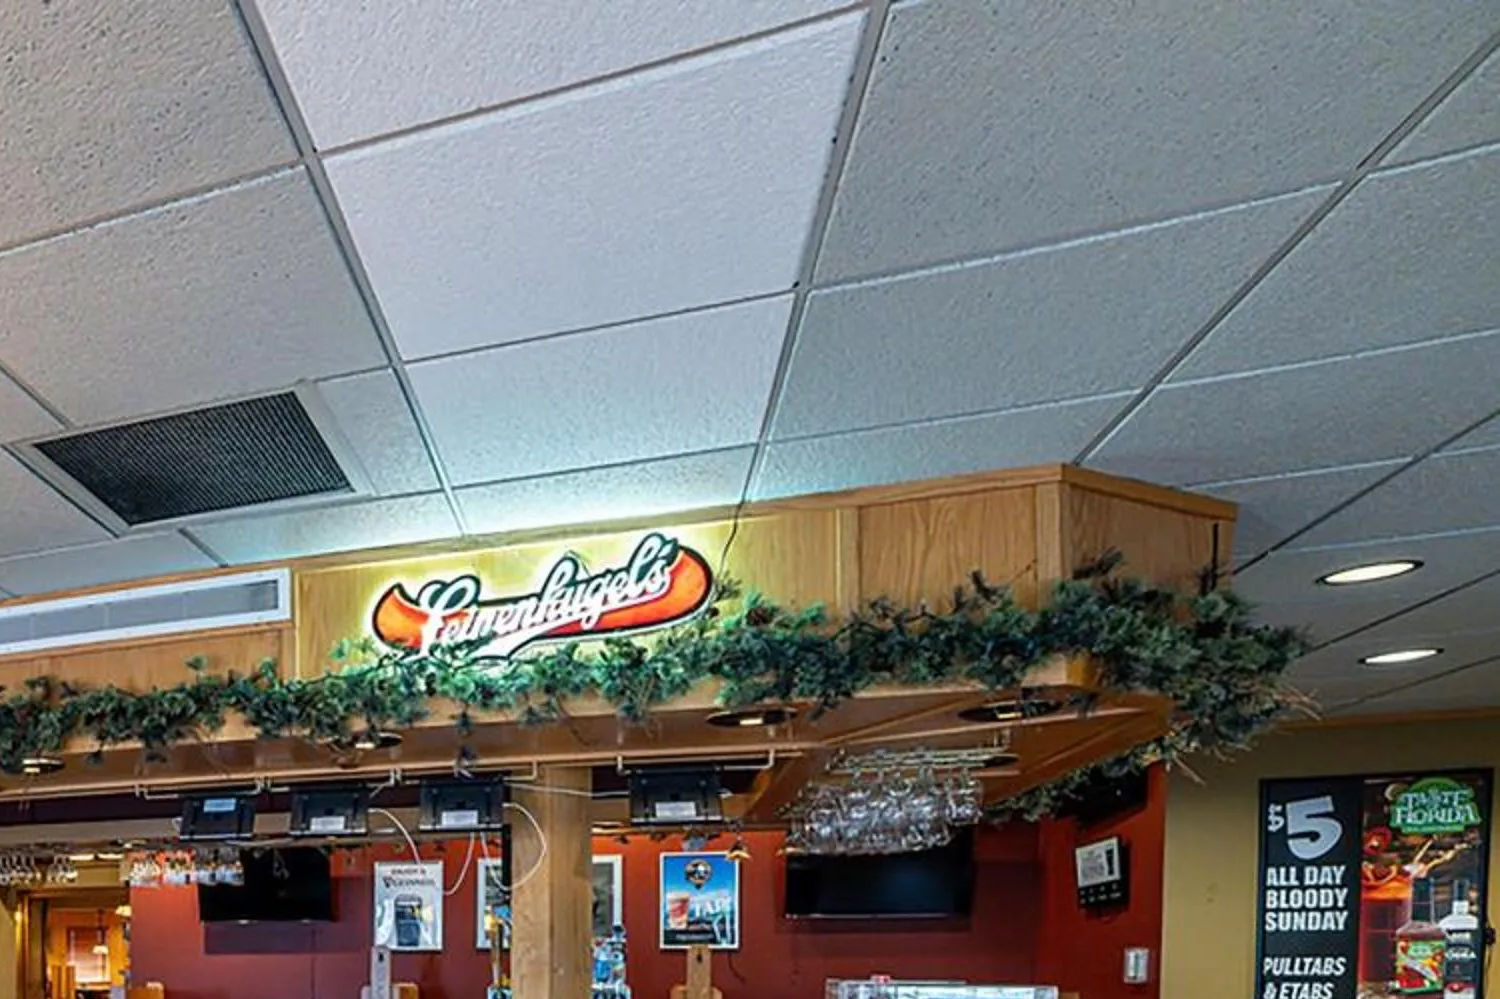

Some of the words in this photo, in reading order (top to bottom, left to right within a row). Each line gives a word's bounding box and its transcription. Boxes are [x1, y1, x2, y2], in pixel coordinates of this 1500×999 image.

[1266, 866, 1300, 887] ALL
[1303, 865, 1346, 886] DAY
[1265, 887, 1349, 909] BLOODY
[1265, 911, 1349, 932] SUNDAY
[1263, 957, 1347, 977] PULLTABS
